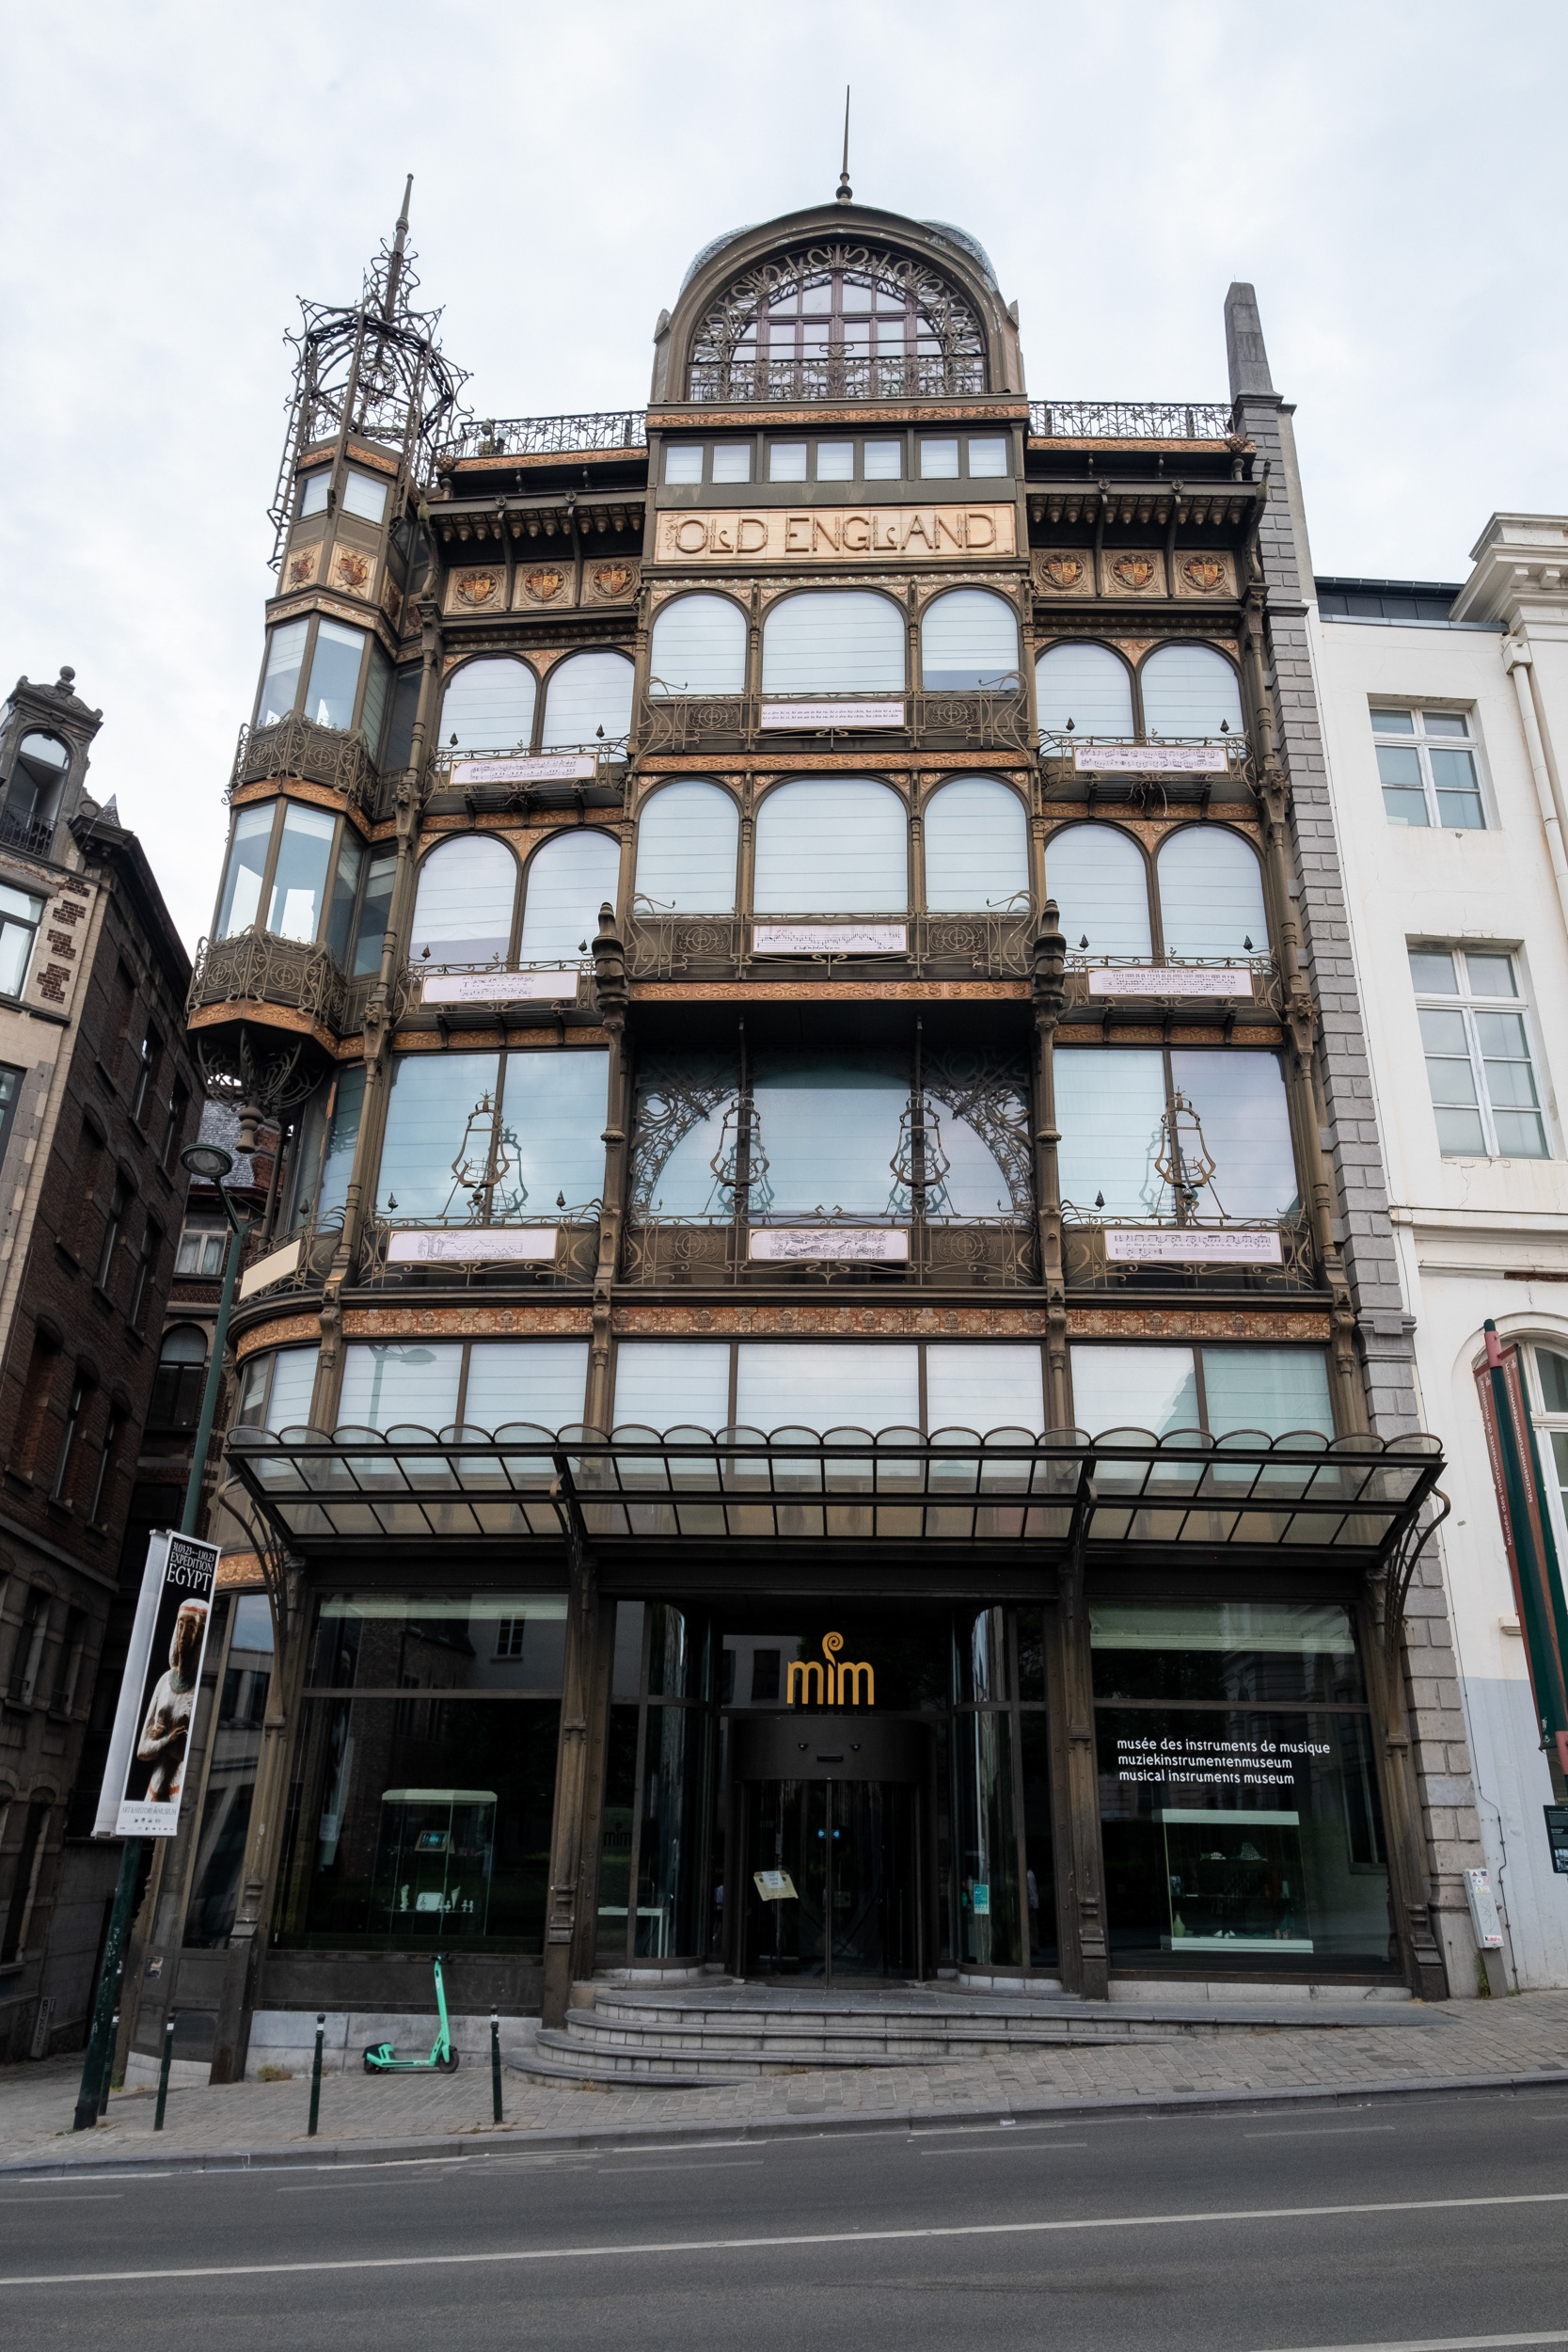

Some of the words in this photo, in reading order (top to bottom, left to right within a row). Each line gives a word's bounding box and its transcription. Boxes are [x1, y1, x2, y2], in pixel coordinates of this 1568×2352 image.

[675, 517, 768, 554] OLD
[784, 513, 997, 554] ENGLAND
[1487, 1422, 1493, 1434] de
[1505, 1362, 1533, 1503] Muziekinstrumentenmuseum
[1489, 1435, 1503, 1494] instruments
[170, 1551, 214, 1573] EXPEDITION
[166, 1563, 213, 1592] EGYPT
[787, 1631, 875, 1706] mim
[1117, 1737, 1157, 1750] musée
[1160, 1738, 1182, 1750] des
[1185, 1739, 1258, 1752] instruments
[1260, 1740, 1276, 1753] de
[1279, 1741, 1330, 1756] musique
[1118, 1754, 1292, 1769] muziekinstrumentenmuseum
[1119, 1770, 1164, 1782] musical
[1168, 1770, 1241, 1784] instruments
[1243, 1774, 1294, 1785] museum
